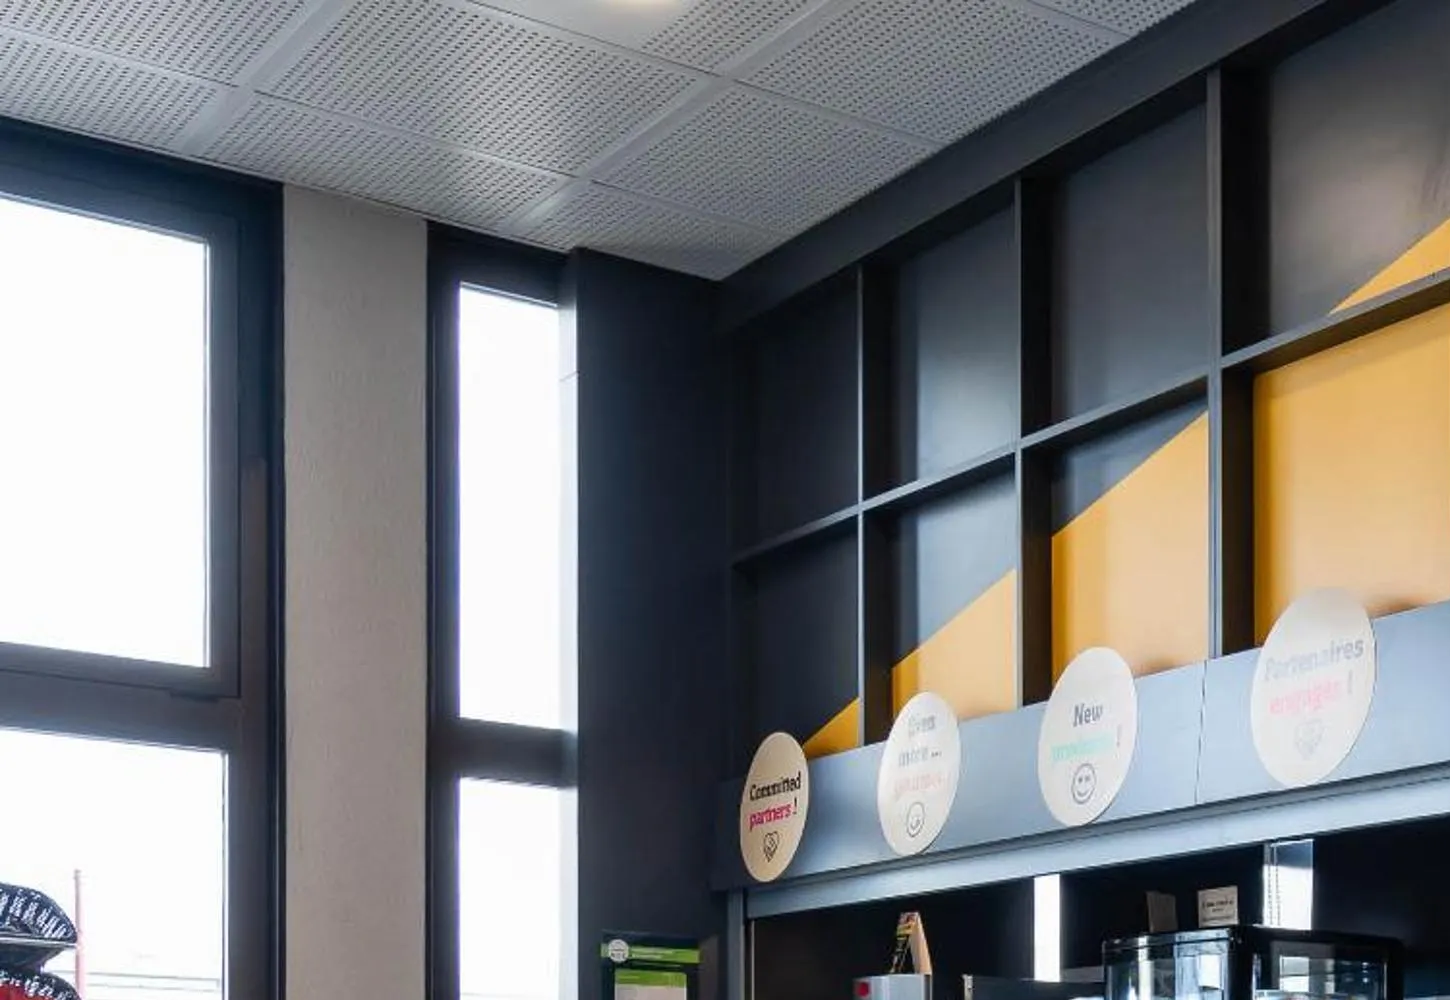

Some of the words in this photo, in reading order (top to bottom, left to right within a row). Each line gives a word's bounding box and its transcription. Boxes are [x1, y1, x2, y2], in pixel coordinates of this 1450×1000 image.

[1073, 703, 1103, 727] New
[750, 770, 802, 801] Committed
[748, 803, 792, 832] partners
